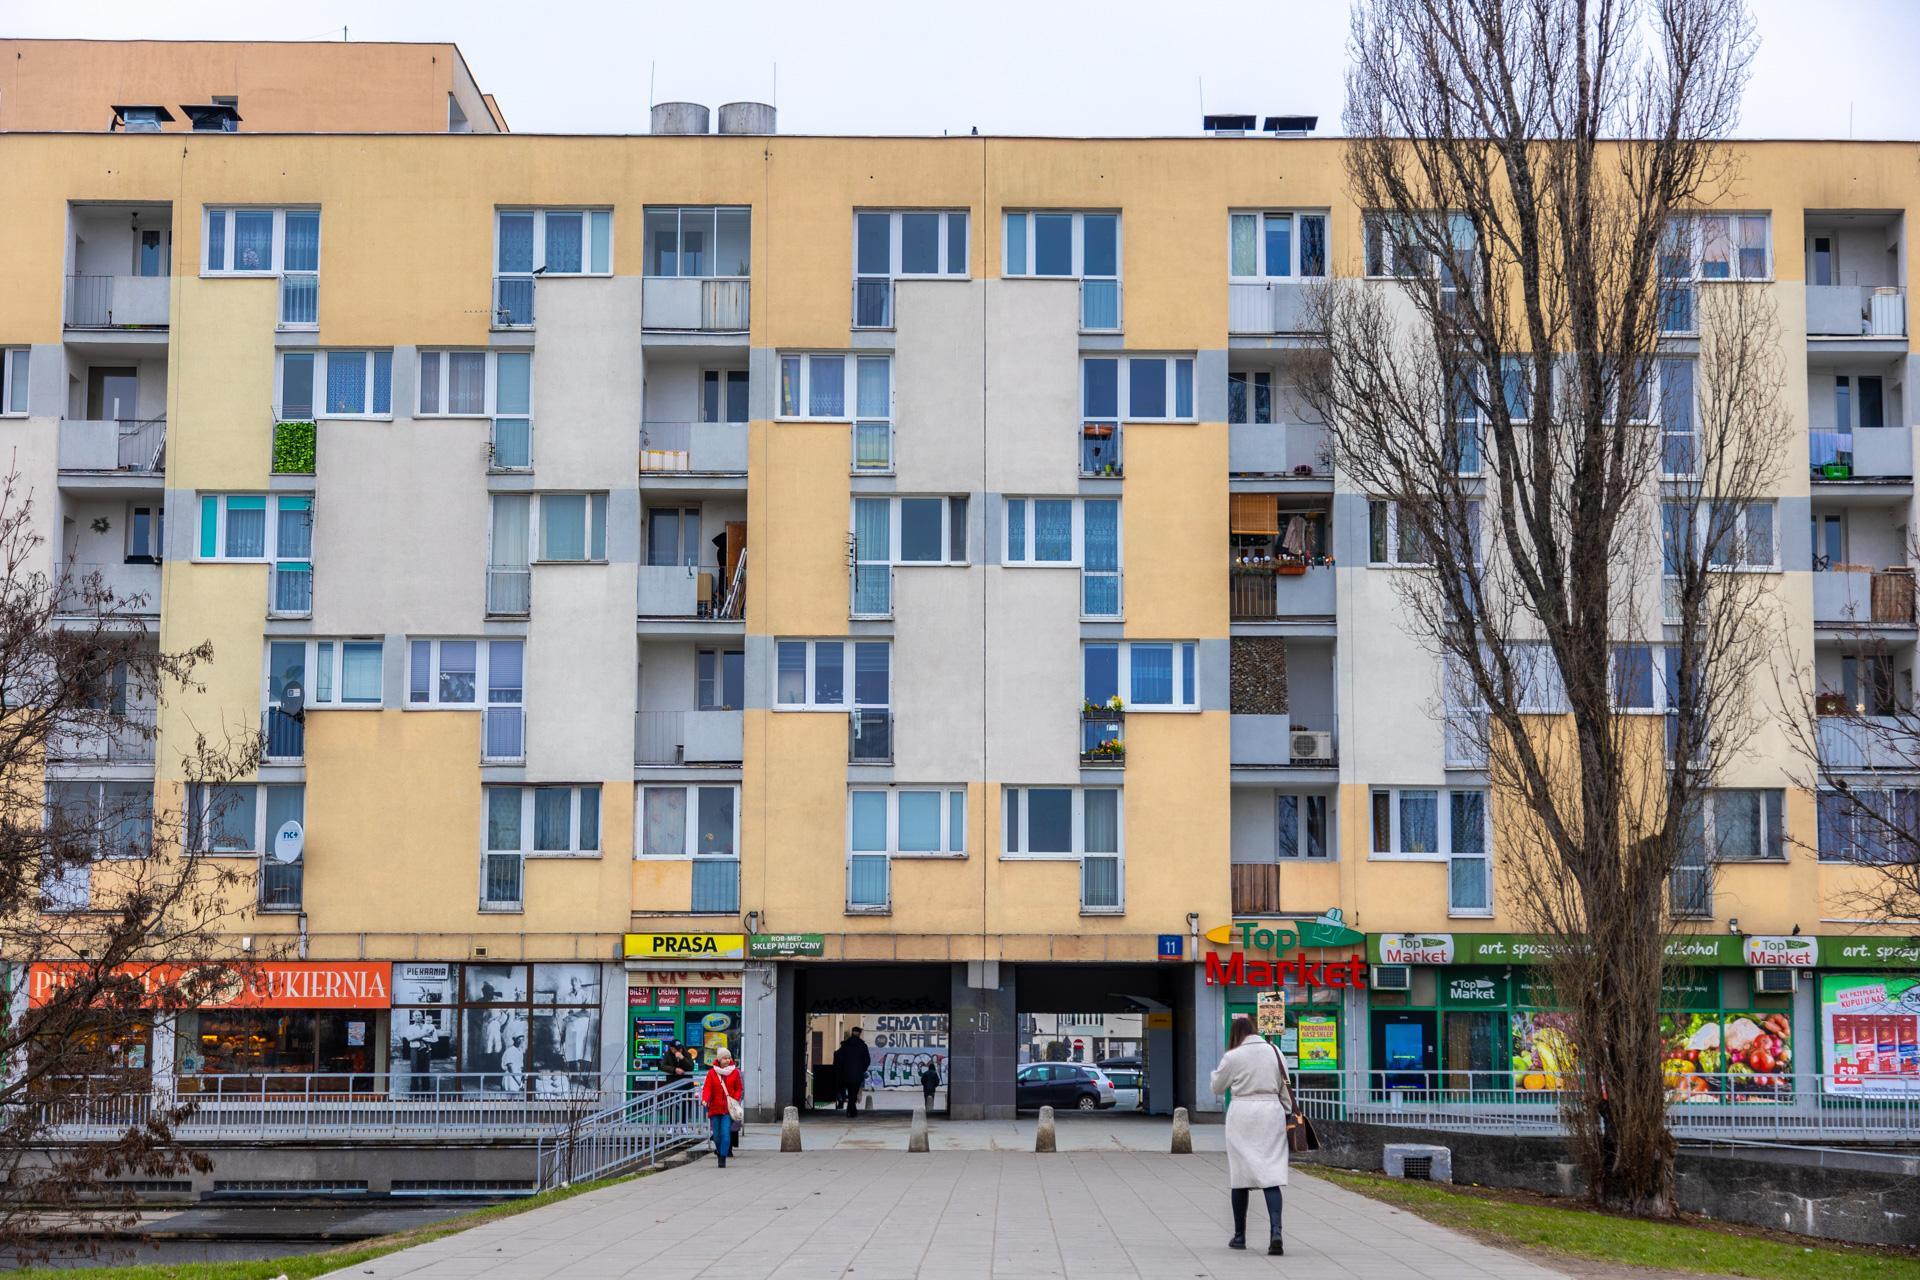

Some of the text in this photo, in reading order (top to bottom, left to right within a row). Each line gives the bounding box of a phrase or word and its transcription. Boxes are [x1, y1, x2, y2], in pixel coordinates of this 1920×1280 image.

[652, 936, 718, 953] PRASA
[752, 942, 821, 951] SKLEP MEDYCZNY
[1235, 922, 1297, 958] Top
[1397, 938, 1421, 951] Top
[1762, 940, 1785, 952] Top
[1165, 941, 1176, 954] 11
[1479, 942, 1506, 955] art.
[1843, 944, 1871, 957] art.
[1387, 949, 1447, 963] Market
[1751, 951, 1811, 965] Market
[407, 967, 446, 976] PIEKARNIA
[1205, 952, 1366, 989] Market
[249, 971, 386, 998] CUKIERNIA
[1457, 979, 1476, 990] Top
[1450, 988, 1495, 999] Market
